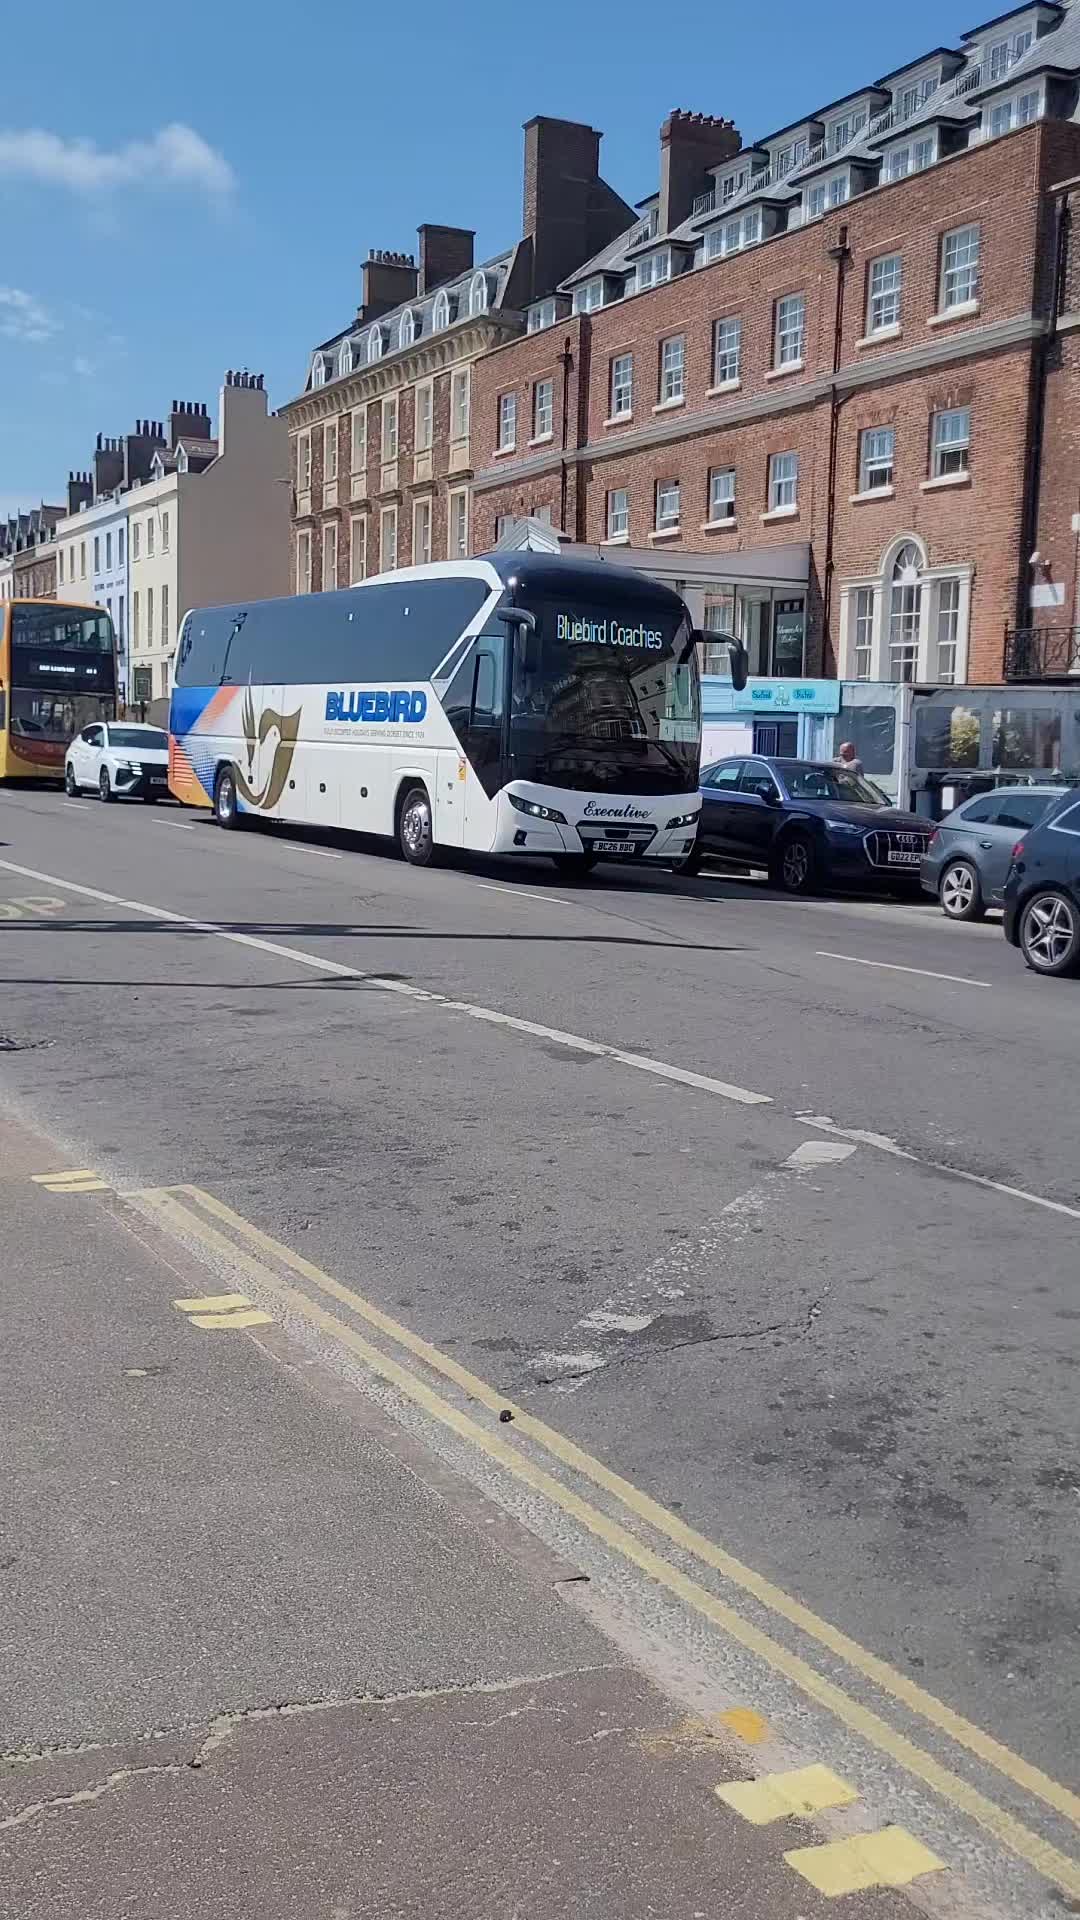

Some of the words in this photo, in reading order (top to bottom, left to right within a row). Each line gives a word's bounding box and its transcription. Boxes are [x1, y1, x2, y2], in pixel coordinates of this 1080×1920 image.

[557, 614, 607, 644] Bluebird
[610, 620, 663, 650] Coaches
[325, 690, 428, 722] BLUEBIRD
[583, 800, 653, 819] Executive
